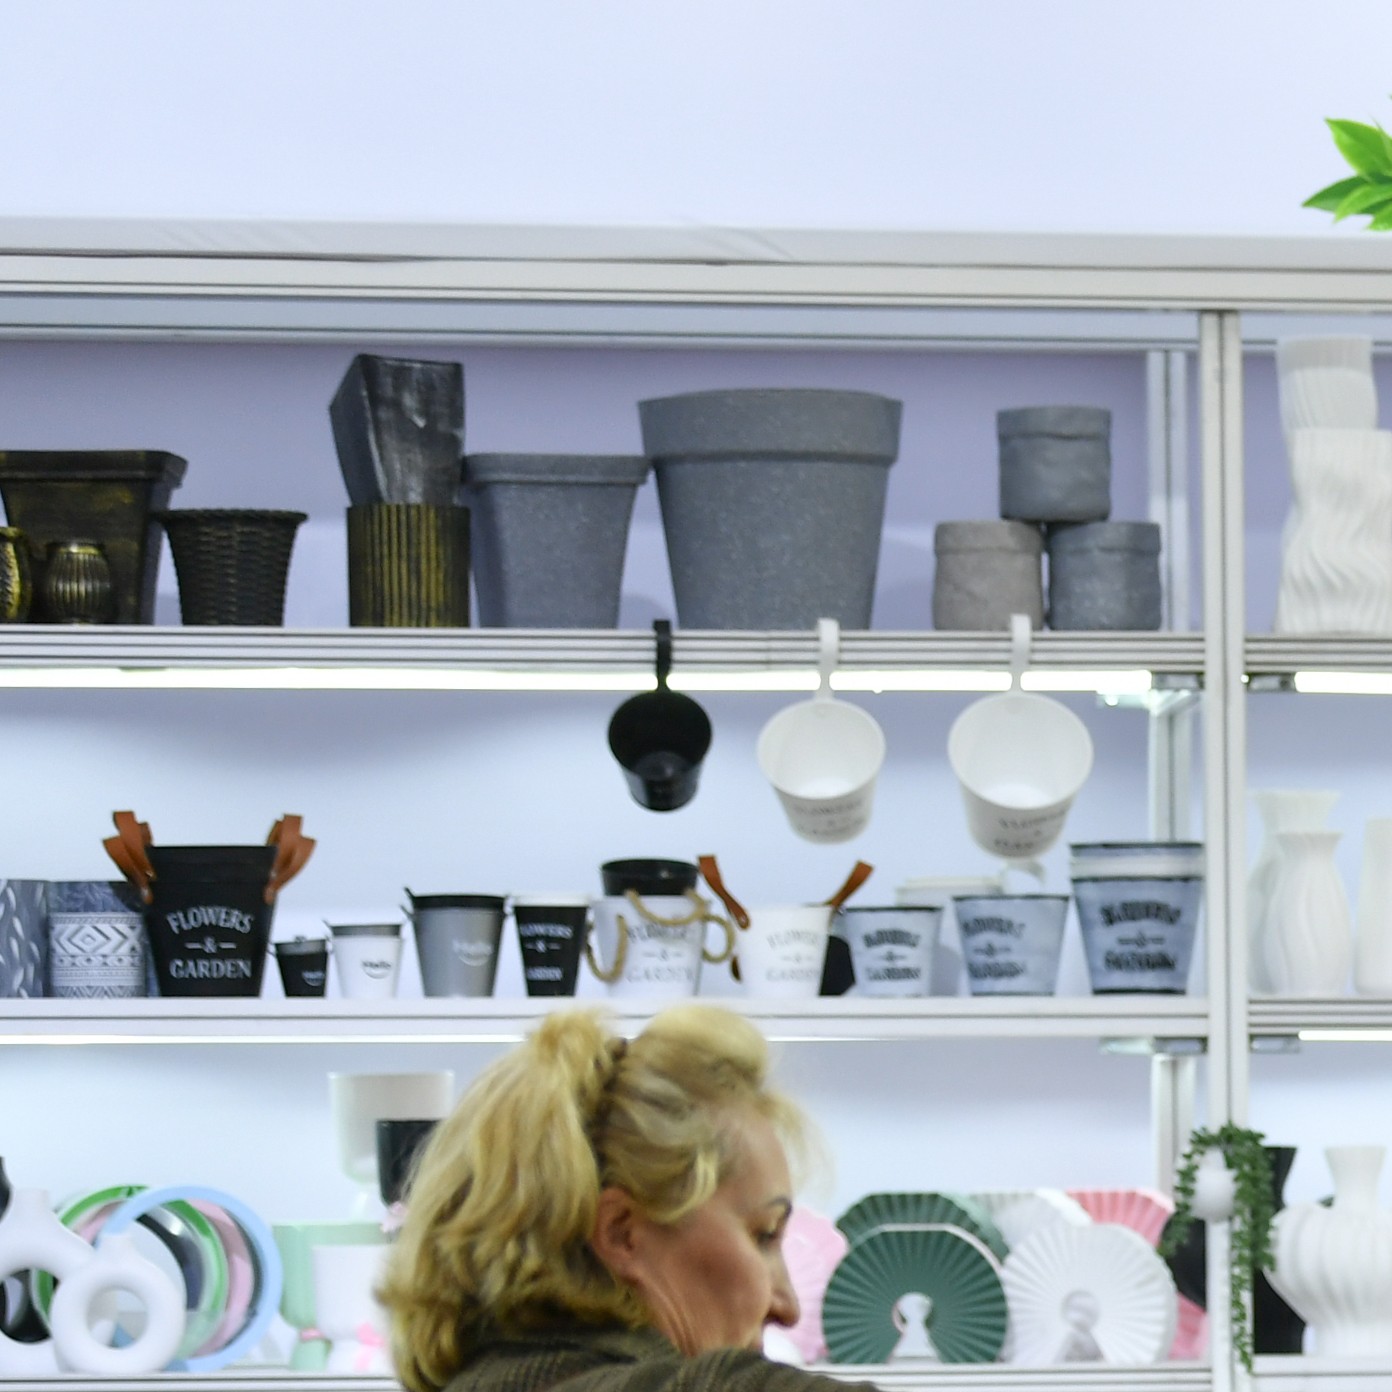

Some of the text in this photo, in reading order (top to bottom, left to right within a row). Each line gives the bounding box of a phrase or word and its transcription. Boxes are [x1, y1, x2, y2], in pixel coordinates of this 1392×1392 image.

[166, 905, 253, 934] FLOWERS
[203, 936, 217, 953] &
[169, 959, 252, 979] GARDEN
